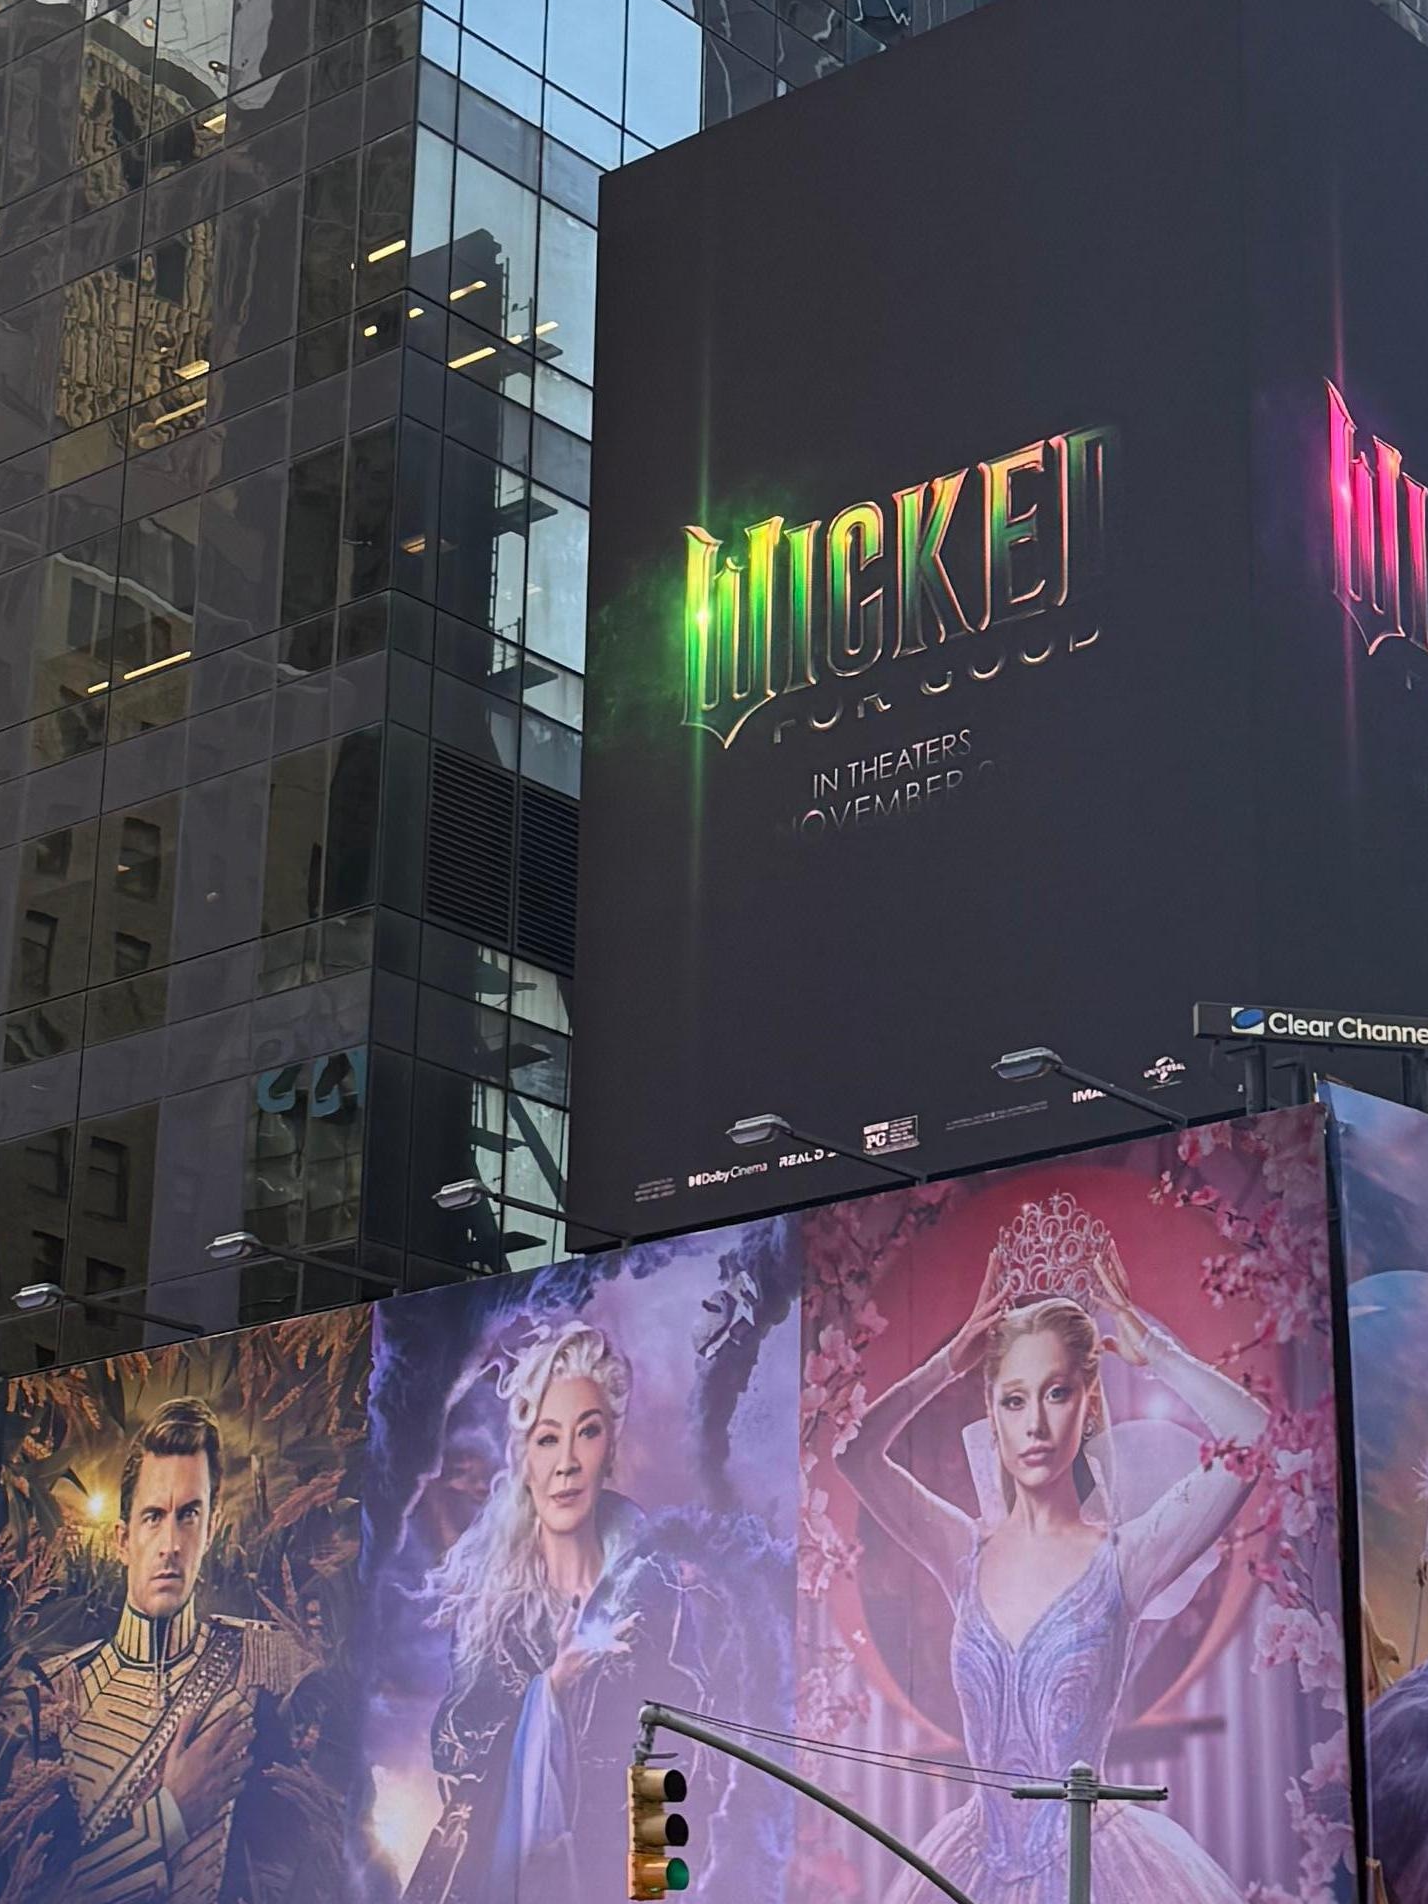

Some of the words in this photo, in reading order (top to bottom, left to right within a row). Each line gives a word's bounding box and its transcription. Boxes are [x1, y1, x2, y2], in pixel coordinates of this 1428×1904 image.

[813, 769, 839, 799] IN
[848, 729, 972, 783] THEATERS
[1269, 1011, 1333, 1038] Clear
[1072, 1088, 1107, 1103] IMA
